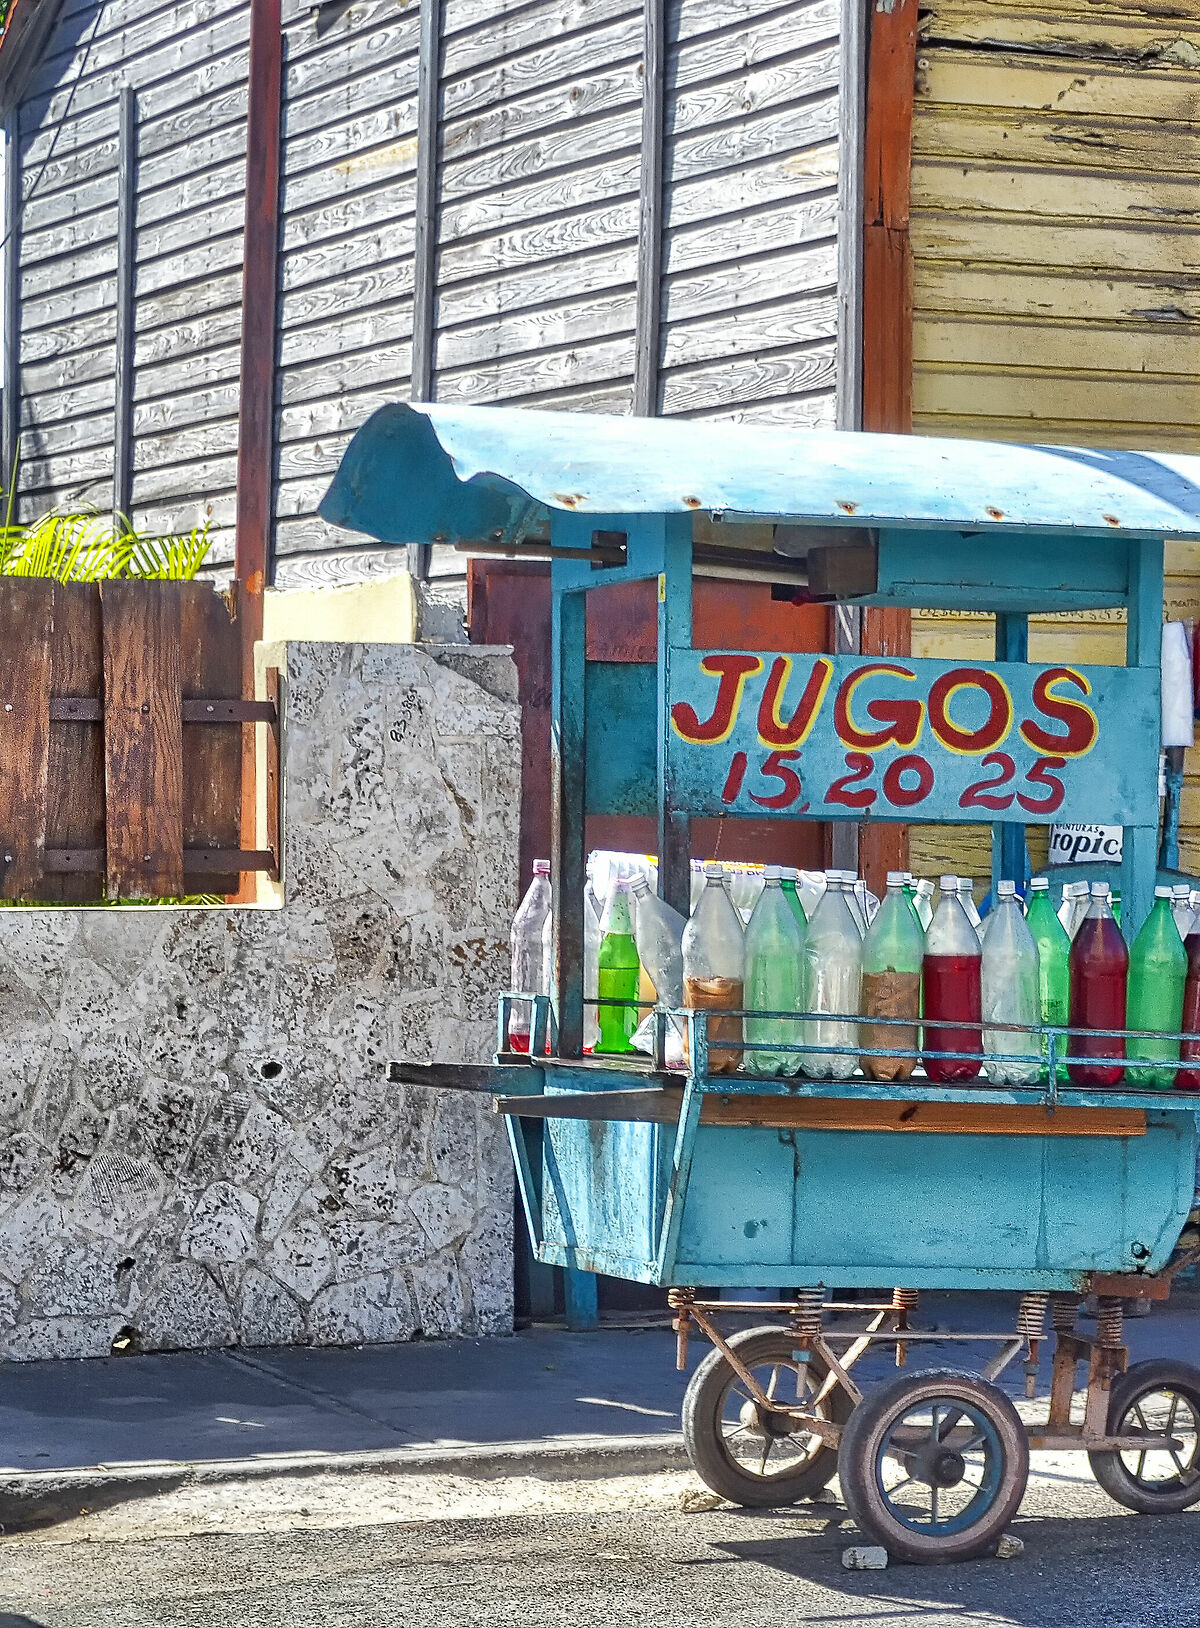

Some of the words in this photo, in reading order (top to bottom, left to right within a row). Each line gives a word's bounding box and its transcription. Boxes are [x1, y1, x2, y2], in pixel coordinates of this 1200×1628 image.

[669, 653, 1099, 757] JUGOS
[823, 750, 936, 809] 20
[959, 751, 1067, 814] 25
[1052, 830, 1122, 862] ropic
